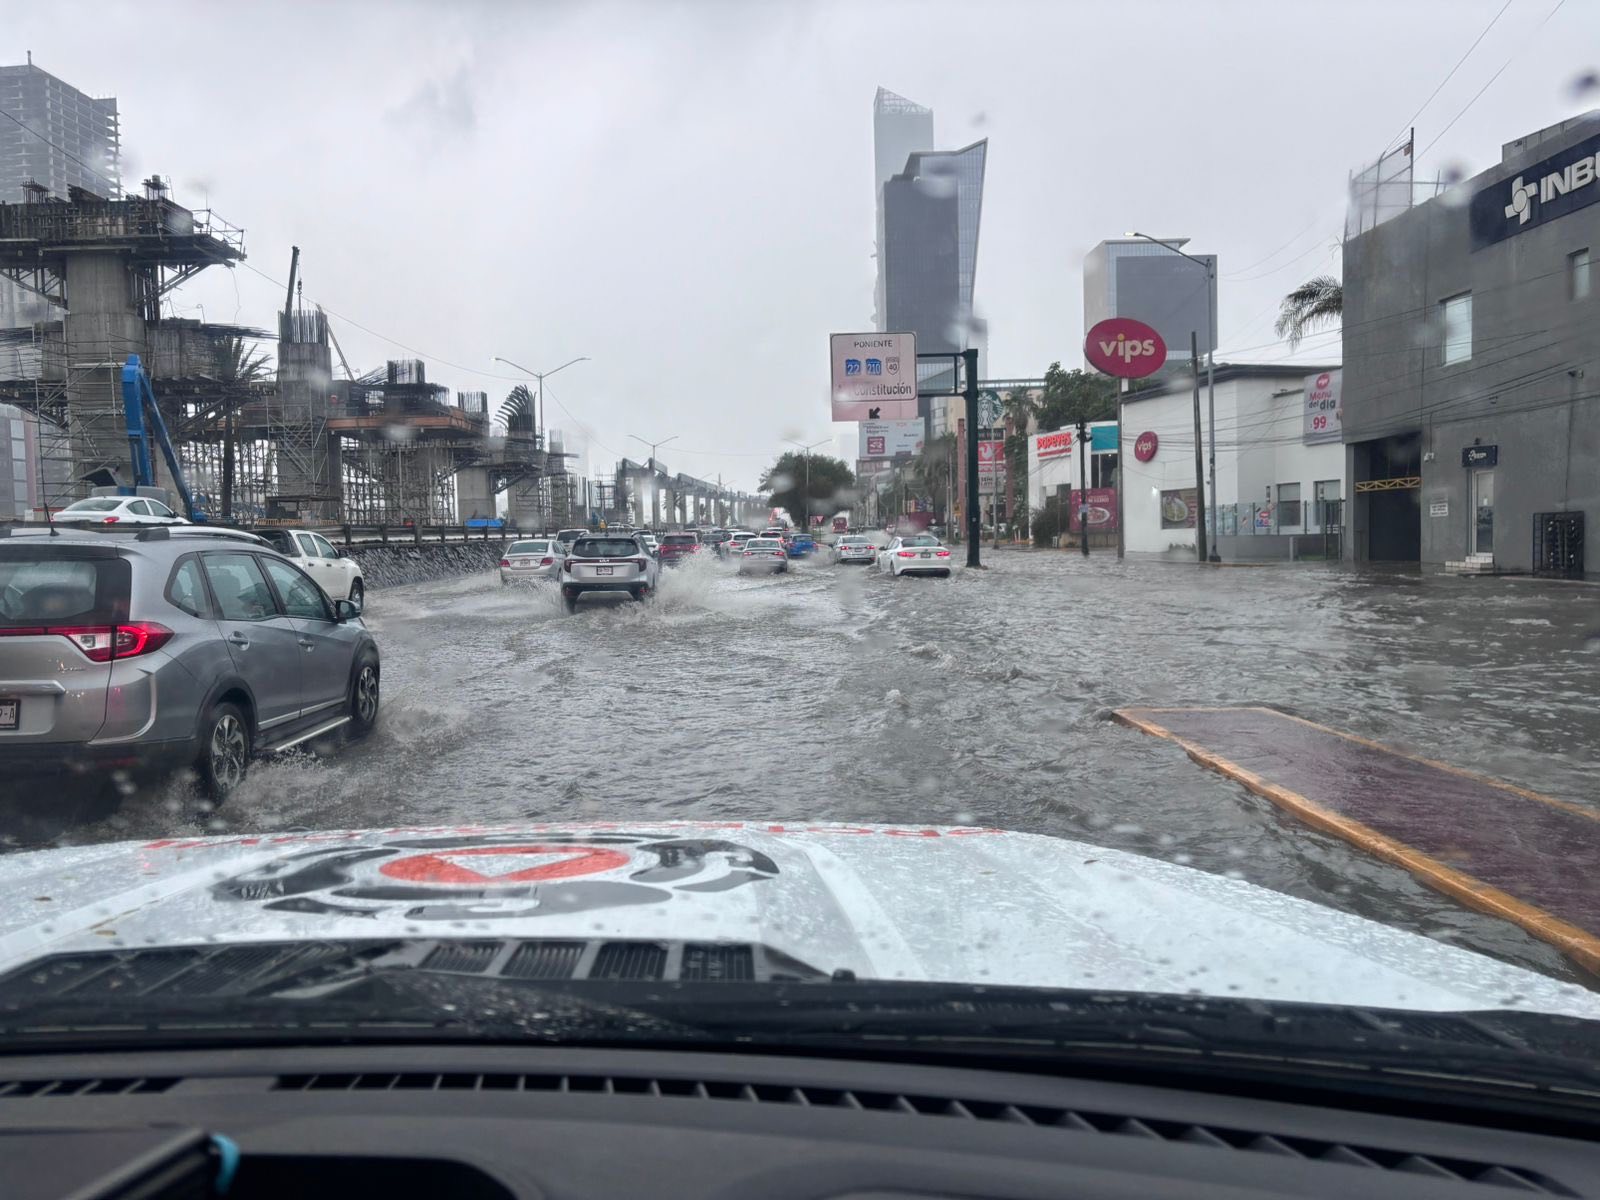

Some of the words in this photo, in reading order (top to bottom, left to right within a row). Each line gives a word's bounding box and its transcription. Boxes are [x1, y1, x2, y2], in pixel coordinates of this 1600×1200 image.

[854, 340, 893, 348] PONIENTE
[1099, 333, 1155, 363] vips
[847, 365, 860, 375] 22
